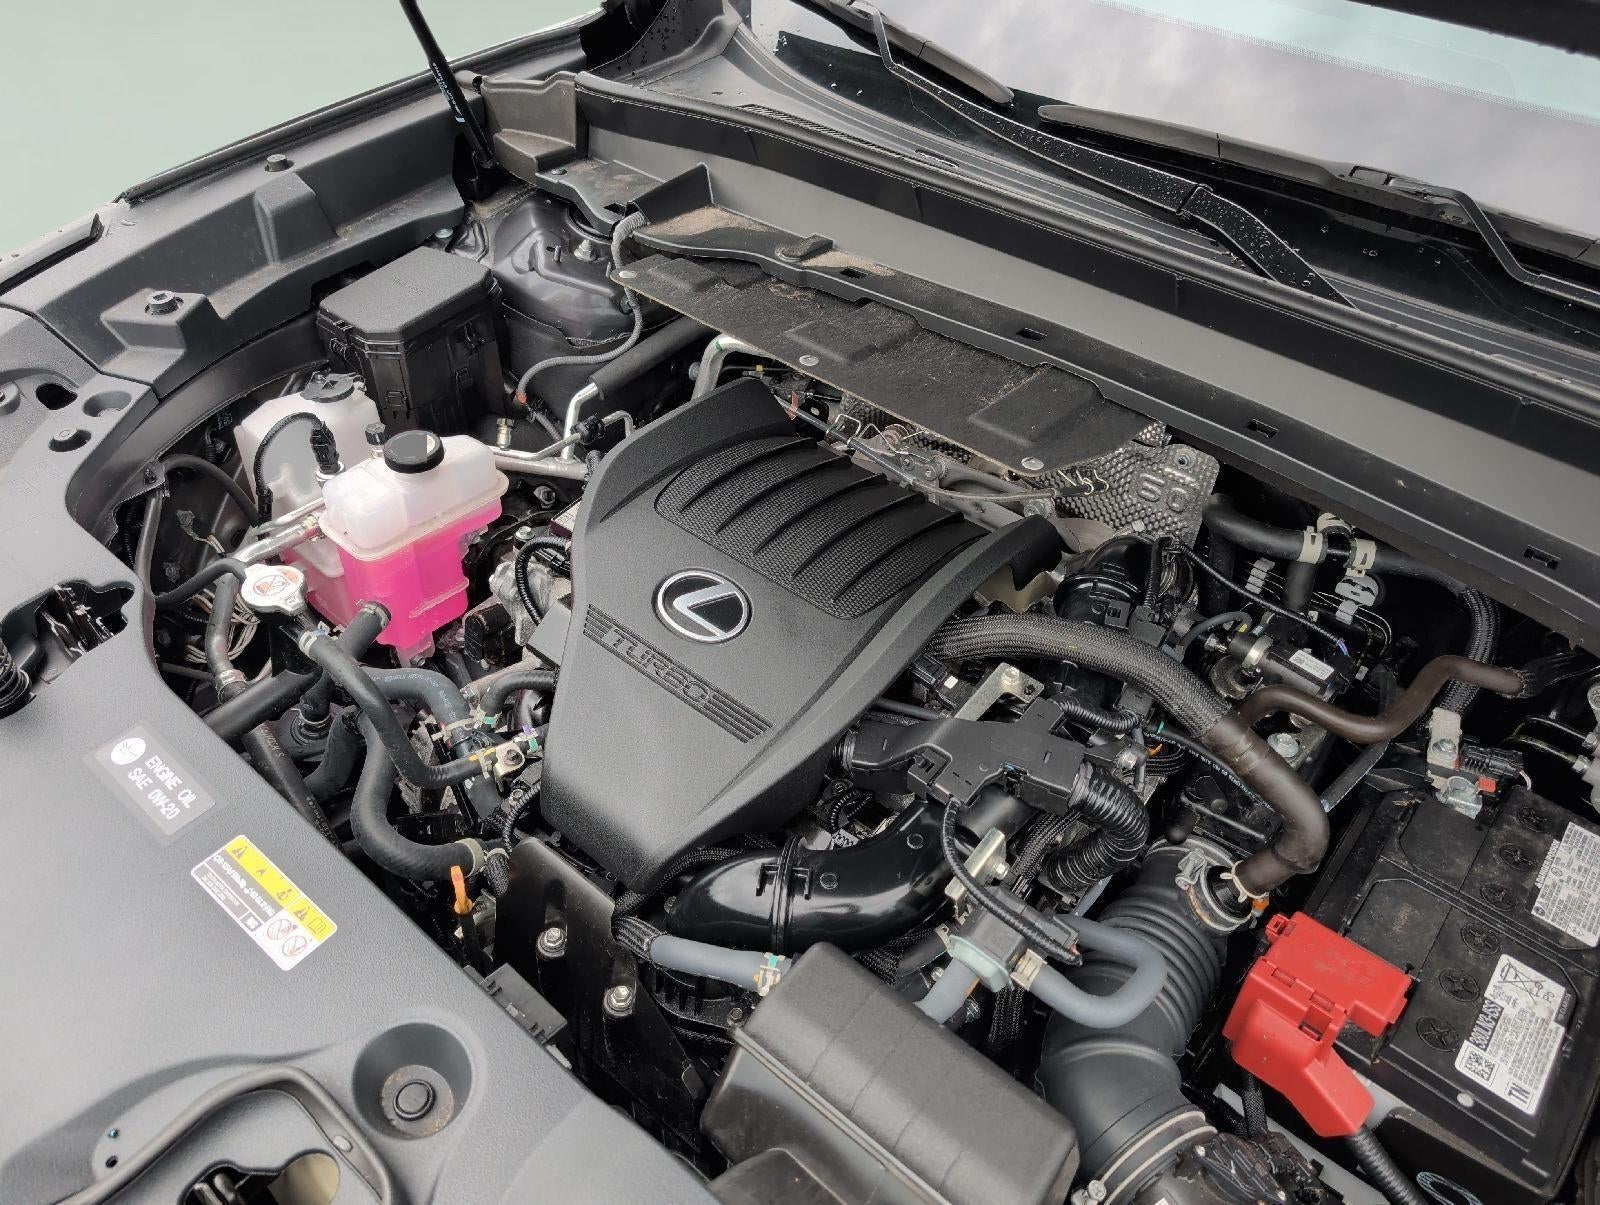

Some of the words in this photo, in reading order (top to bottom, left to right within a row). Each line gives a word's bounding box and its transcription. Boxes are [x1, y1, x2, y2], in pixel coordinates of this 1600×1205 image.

[612, 628, 711, 703] TURBO
[128, 767, 153, 790] SAE
[148, 789, 180, 819] 0W-20
[145, 755, 182, 790] ENGINE
[177, 789, 197, 808] OIL
[1469, 1000, 1502, 1050] 380LN3-ISS
[1508, 1081, 1531, 1104] TN
